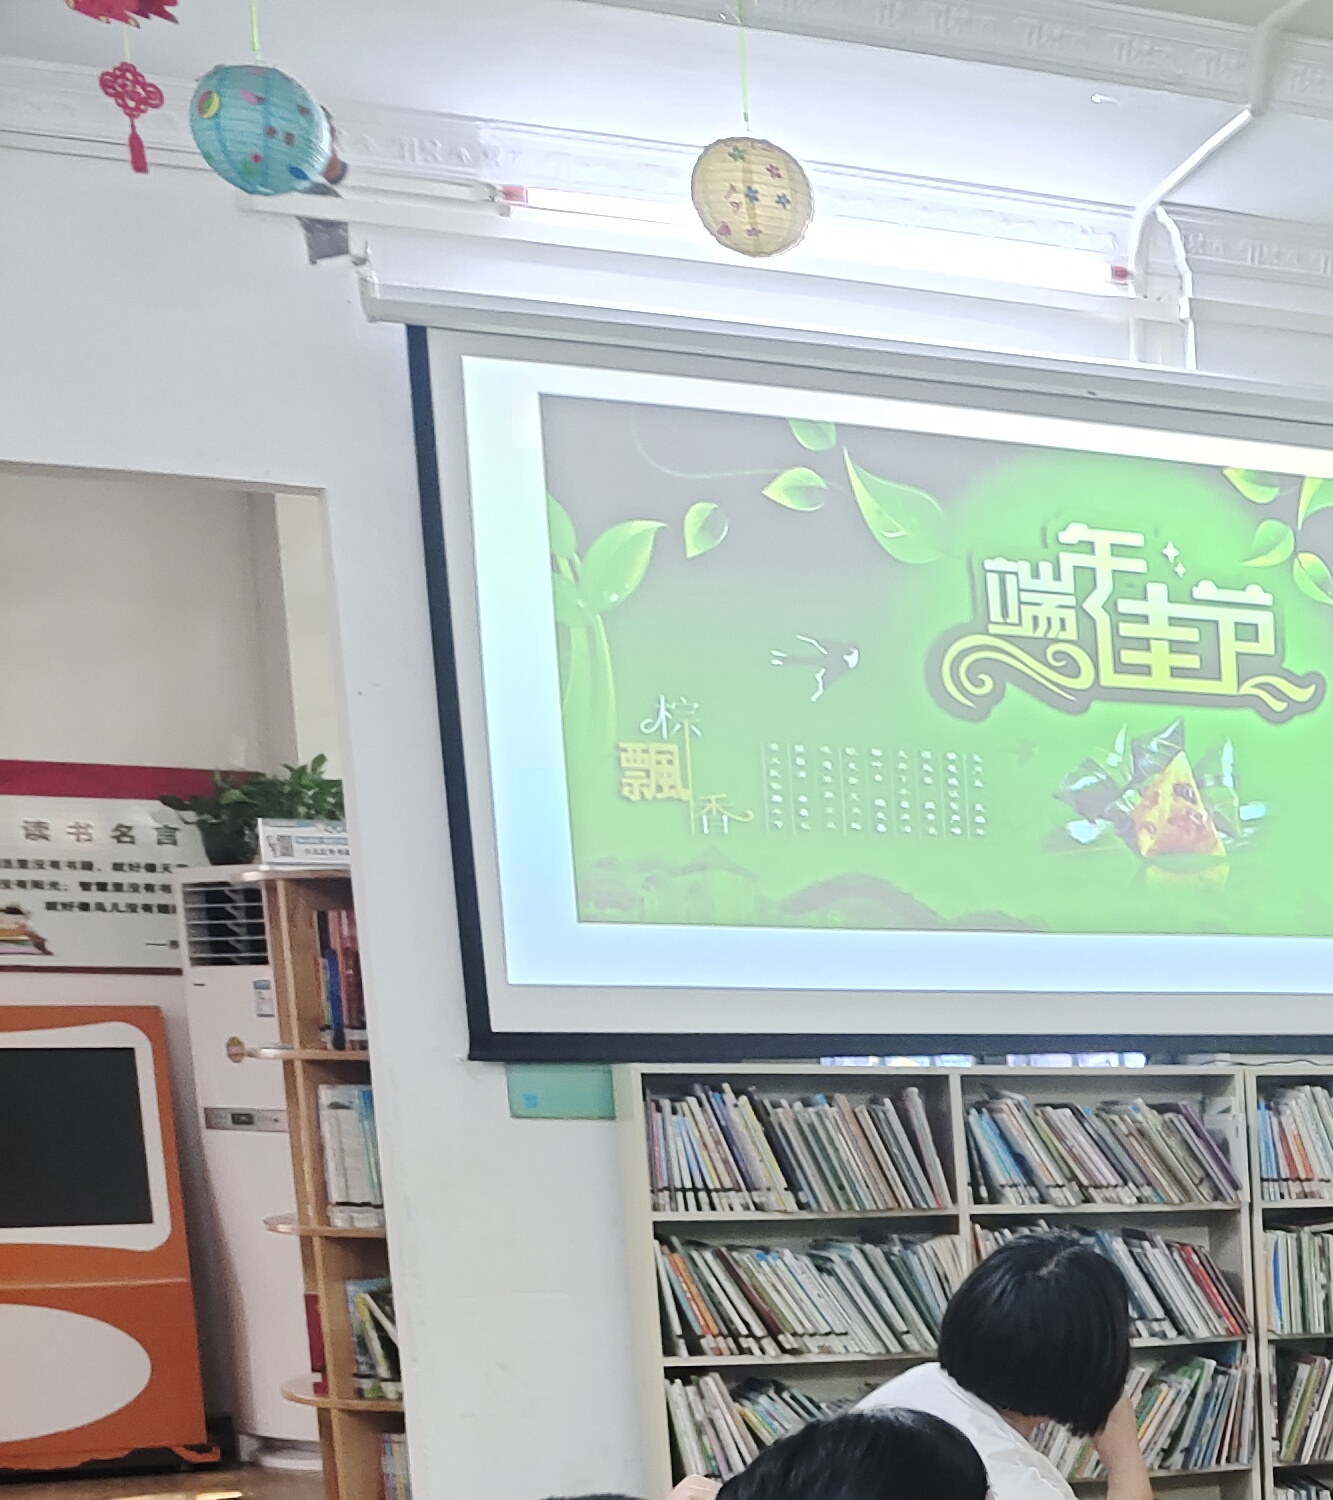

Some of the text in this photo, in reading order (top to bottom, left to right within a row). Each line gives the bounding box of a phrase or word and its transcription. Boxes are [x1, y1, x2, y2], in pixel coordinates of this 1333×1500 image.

[983, 521, 1276, 695] 端午佳节
[21, 820, 181, 847] 读书名言
